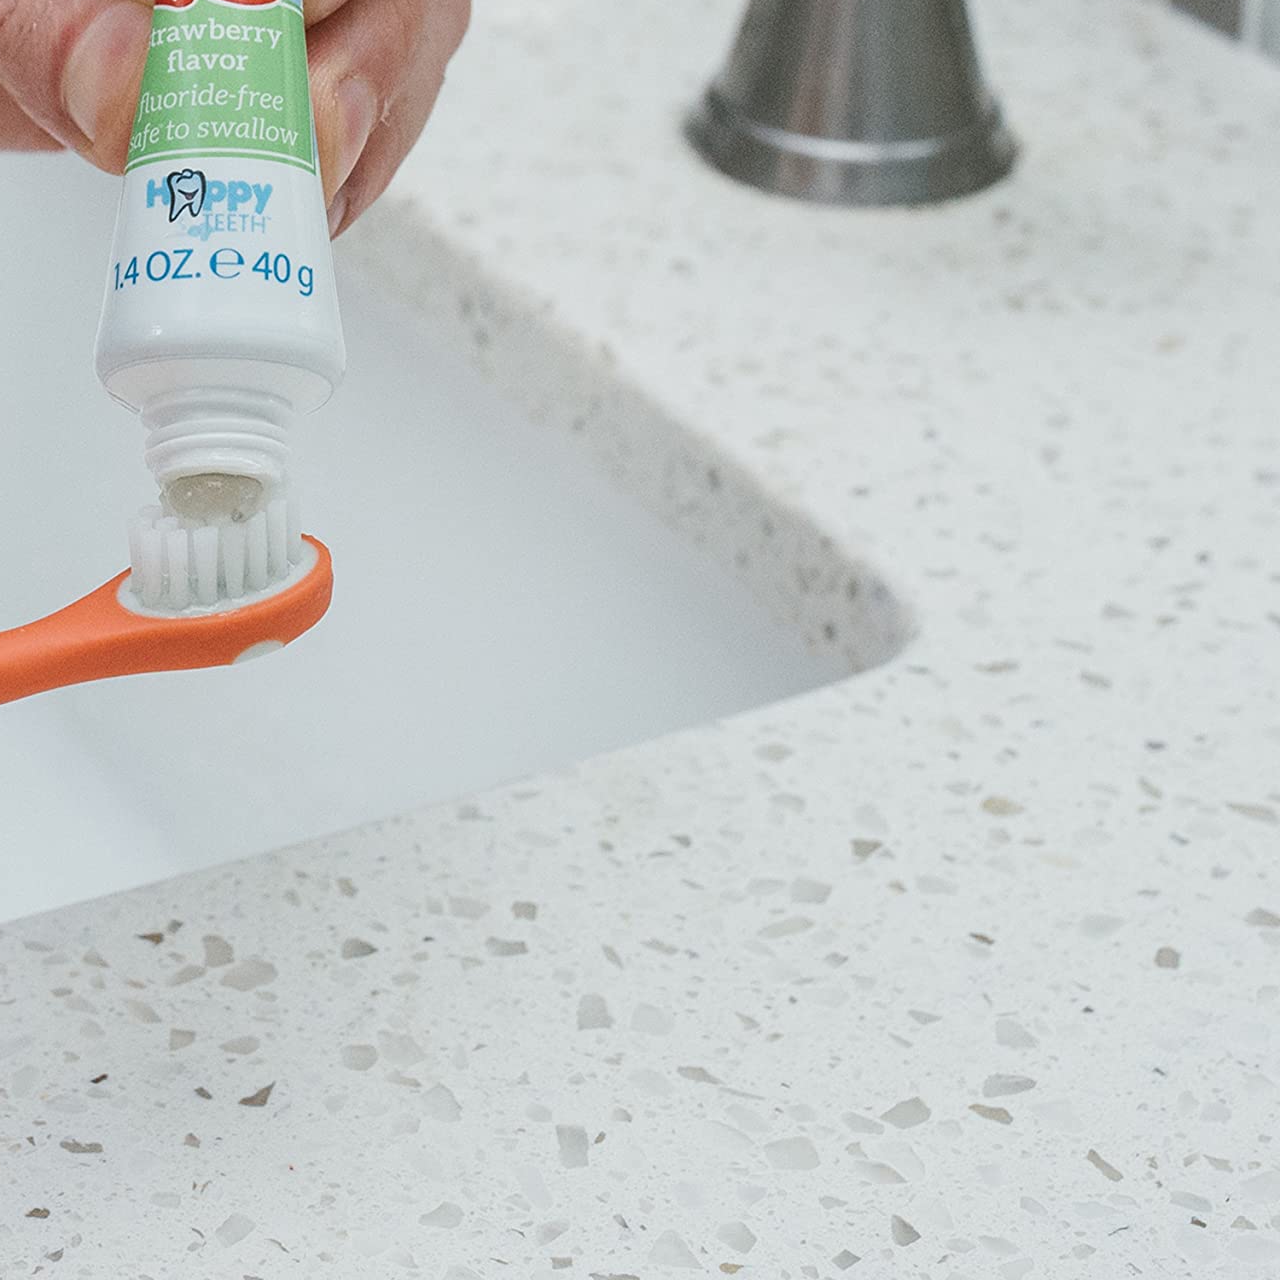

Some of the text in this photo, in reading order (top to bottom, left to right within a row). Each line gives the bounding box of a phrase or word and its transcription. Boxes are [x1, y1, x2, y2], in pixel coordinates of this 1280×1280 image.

[150, 17, 282, 49] trawberry
[167, 48, 248, 73] flavor
[138, 83, 284, 122] fluoride-free
[166, 120, 190, 140] to
[196, 116, 299, 147] swallow
[146, 170, 273, 217] Hppy
[203, 213, 267, 233] TEETH
[114, 256, 140, 291] 1.4
[145, 248, 201, 282] OZ.
[252, 251, 291, 284] 40
[298, 265, 314, 297] g
